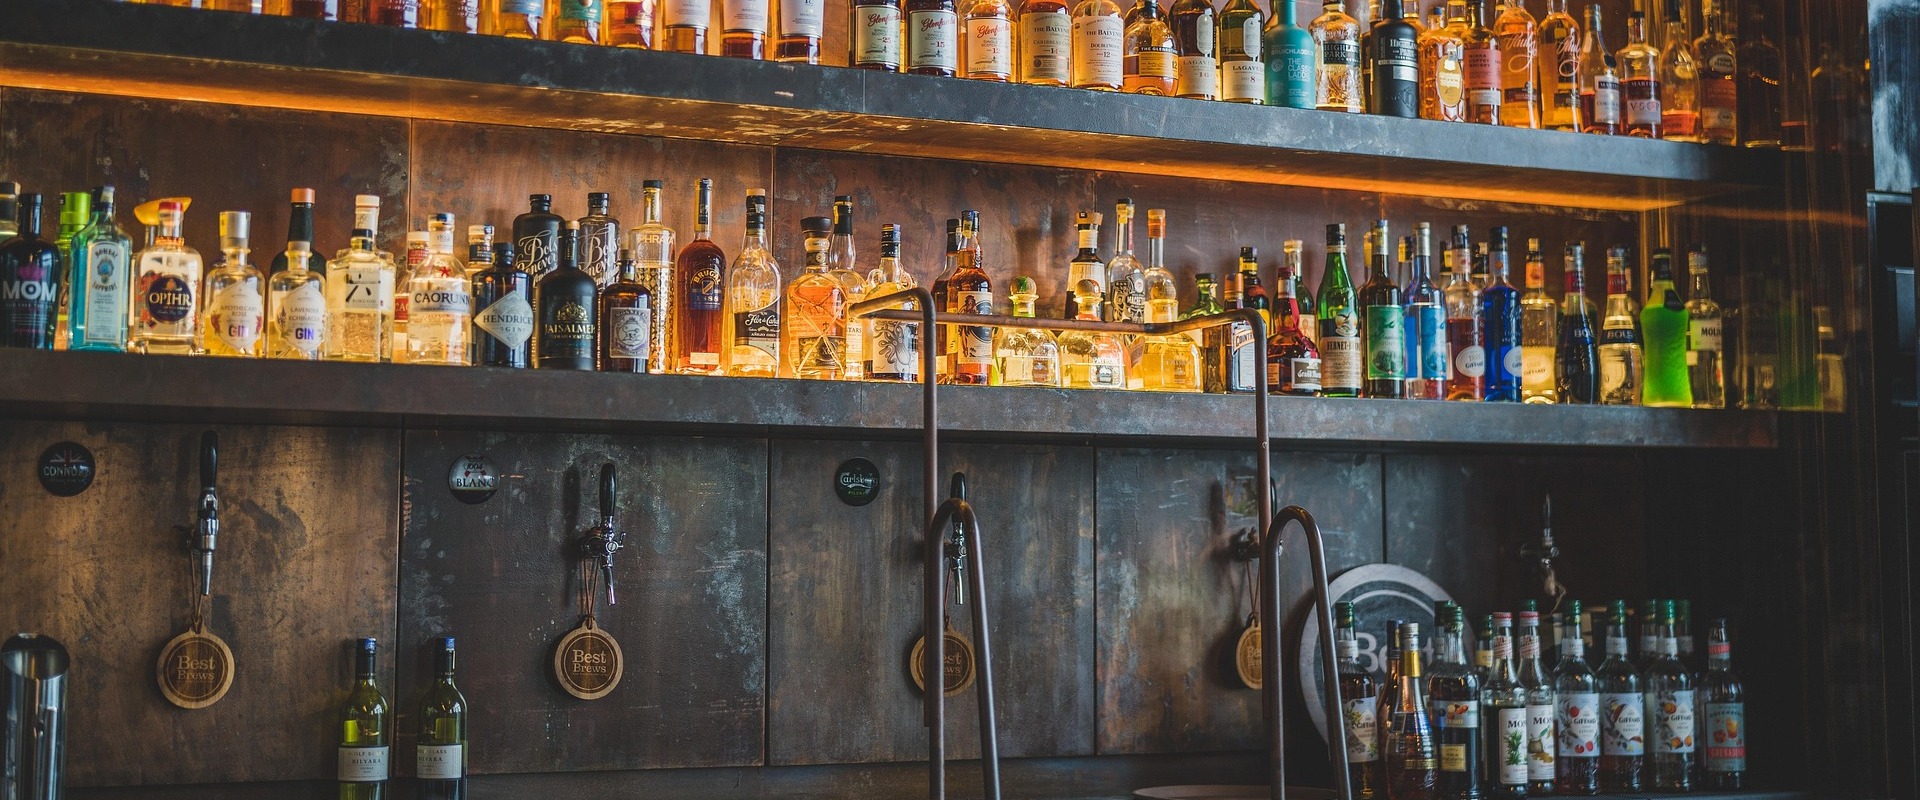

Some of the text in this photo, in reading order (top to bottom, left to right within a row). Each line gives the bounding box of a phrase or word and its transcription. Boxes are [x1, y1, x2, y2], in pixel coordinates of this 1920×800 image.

[1324, 51, 1346, 59] PARK
[94, 248, 119, 259] BOMBAY
[693, 270, 721, 285] BRUGAL
[2, 281, 57, 303] MOM
[149, 292, 192, 306] OPIHR
[295, 327, 314, 340] GIN
[1607, 331, 1633, 339] BOLS
[456, 475, 495, 488] BLANC
[176, 655, 216, 670] Best
[572, 649, 607, 664] Best
[942, 652, 962, 664] est
[572, 662, 607, 673] Brews
[176, 669, 215, 681] Brews
